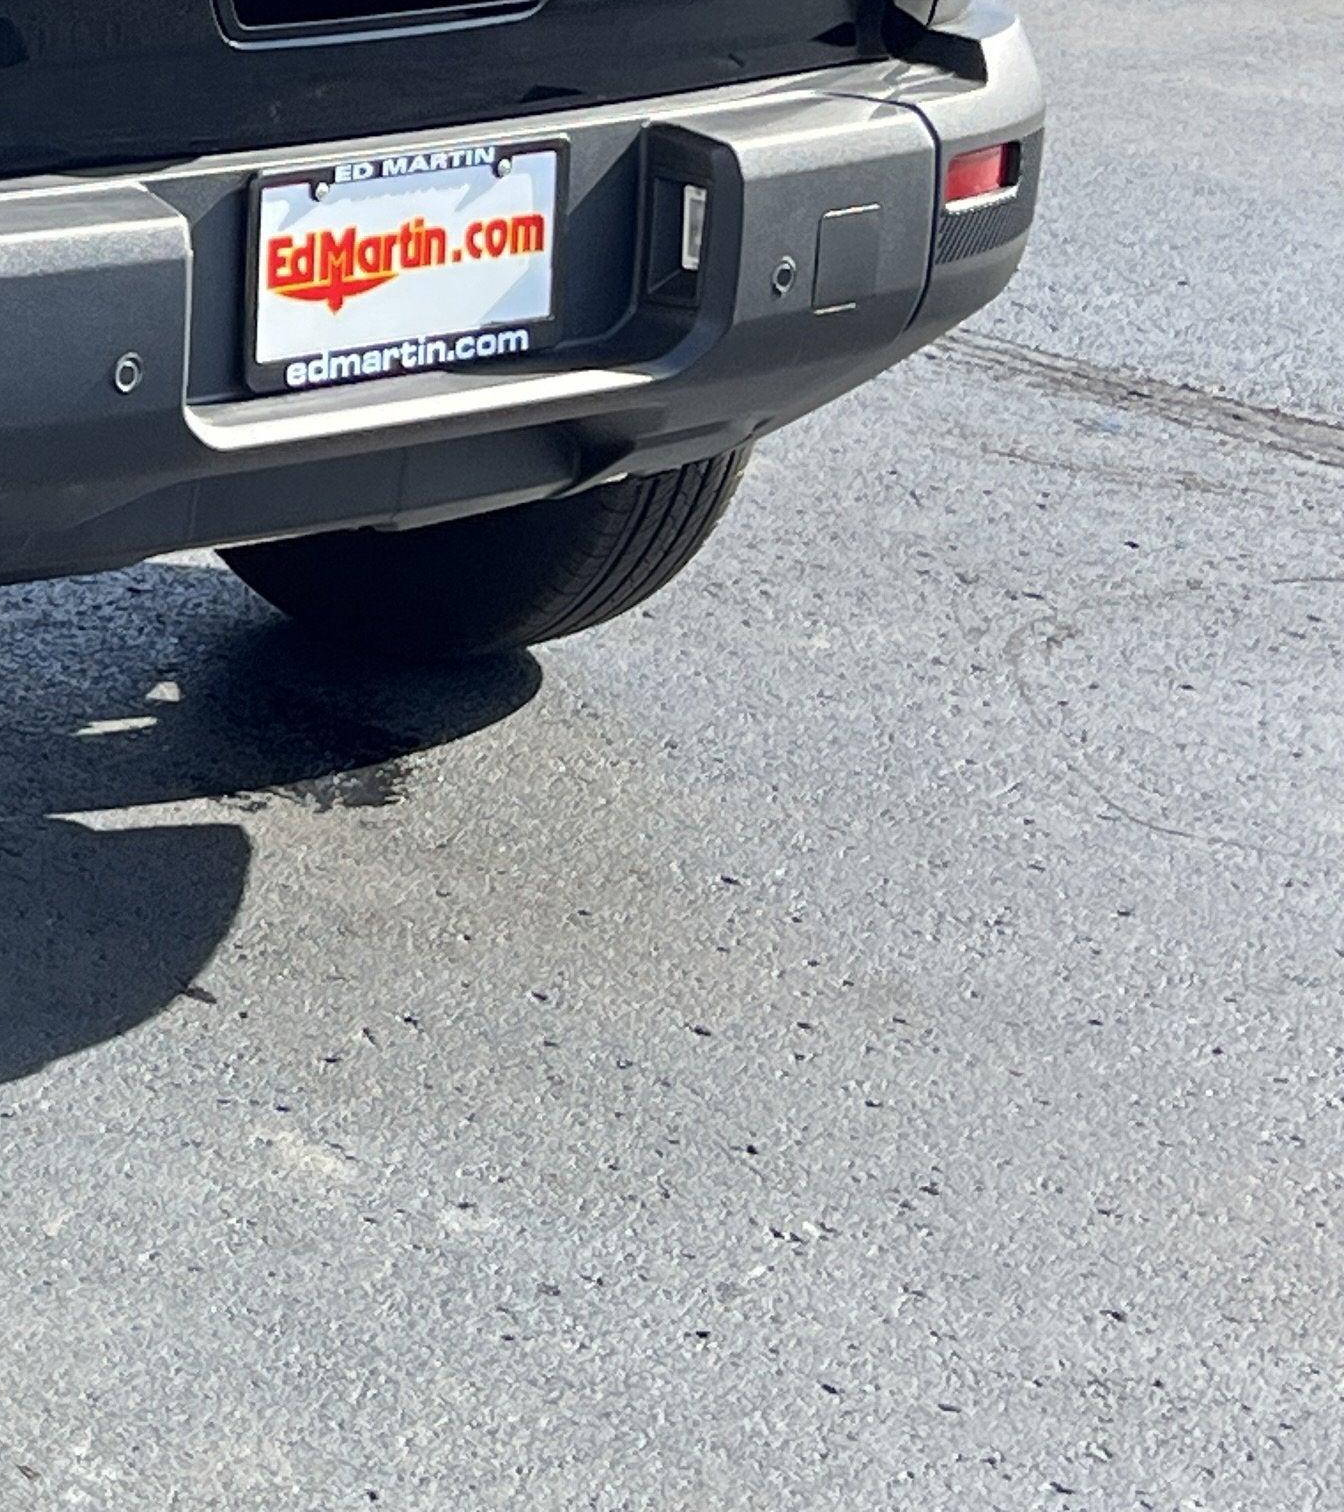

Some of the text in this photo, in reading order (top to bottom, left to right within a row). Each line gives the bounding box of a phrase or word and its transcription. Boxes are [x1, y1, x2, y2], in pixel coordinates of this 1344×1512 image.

[334, 146, 497, 183] ED MARTIN
[266, 213, 545, 291] EdMartin.com
[285, 327, 529, 388] edmartin.com
